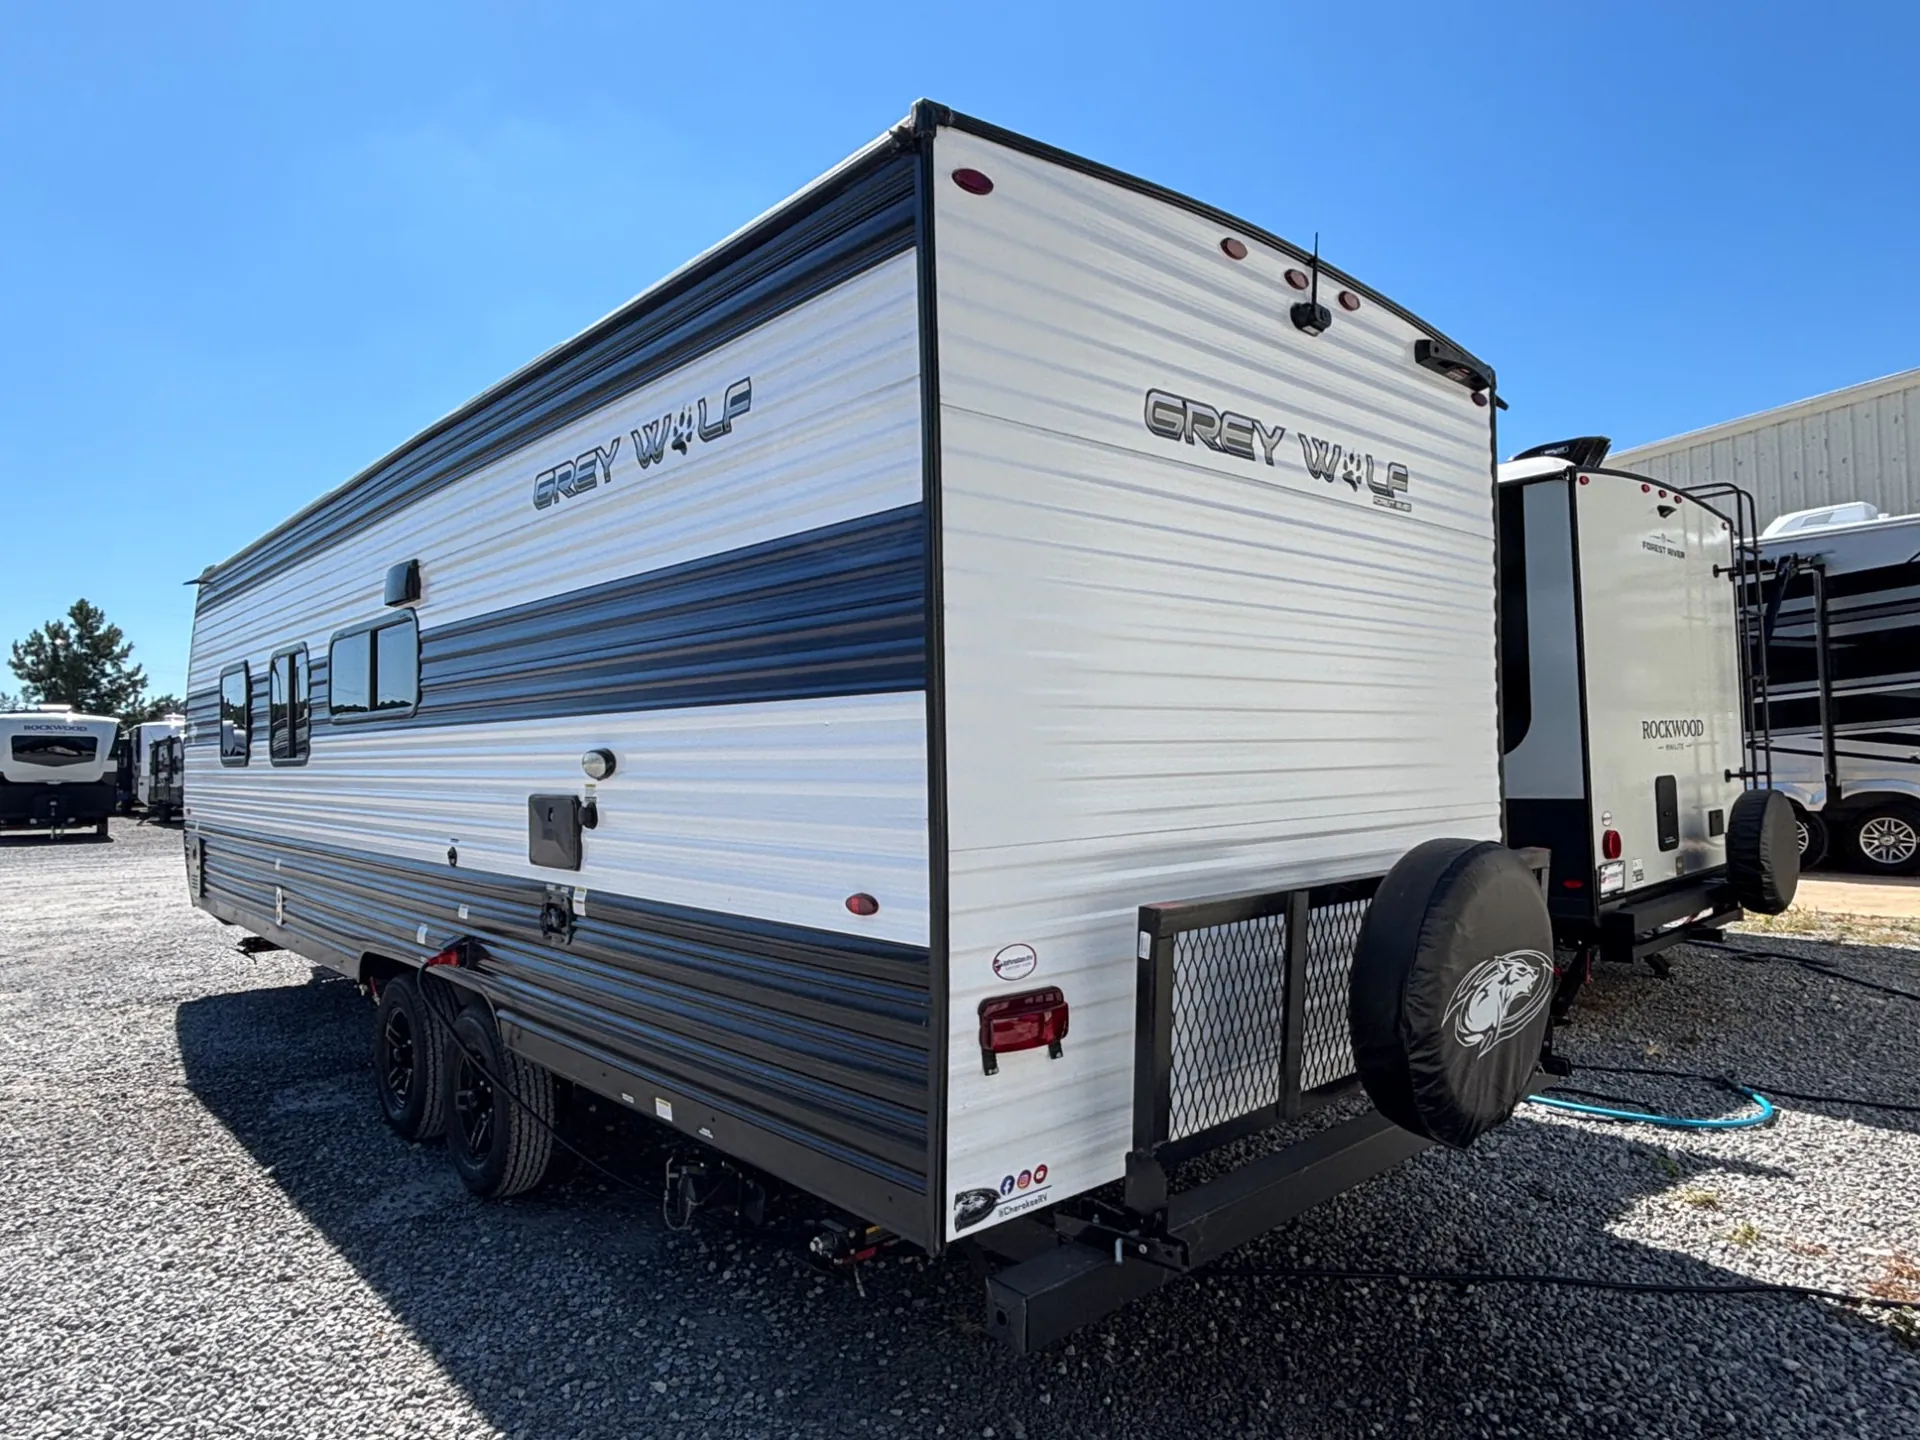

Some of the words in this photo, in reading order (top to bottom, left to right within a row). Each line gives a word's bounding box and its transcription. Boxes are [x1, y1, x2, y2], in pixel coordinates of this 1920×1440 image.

[1144, 387, 1287, 467] GREY
[533, 436, 621, 510] GREY
[1642, 540, 1667, 555] FOREST
[23, 724, 88, 732] ROCKWOOD
[1641, 719, 1704, 740] ROCKWOOD
